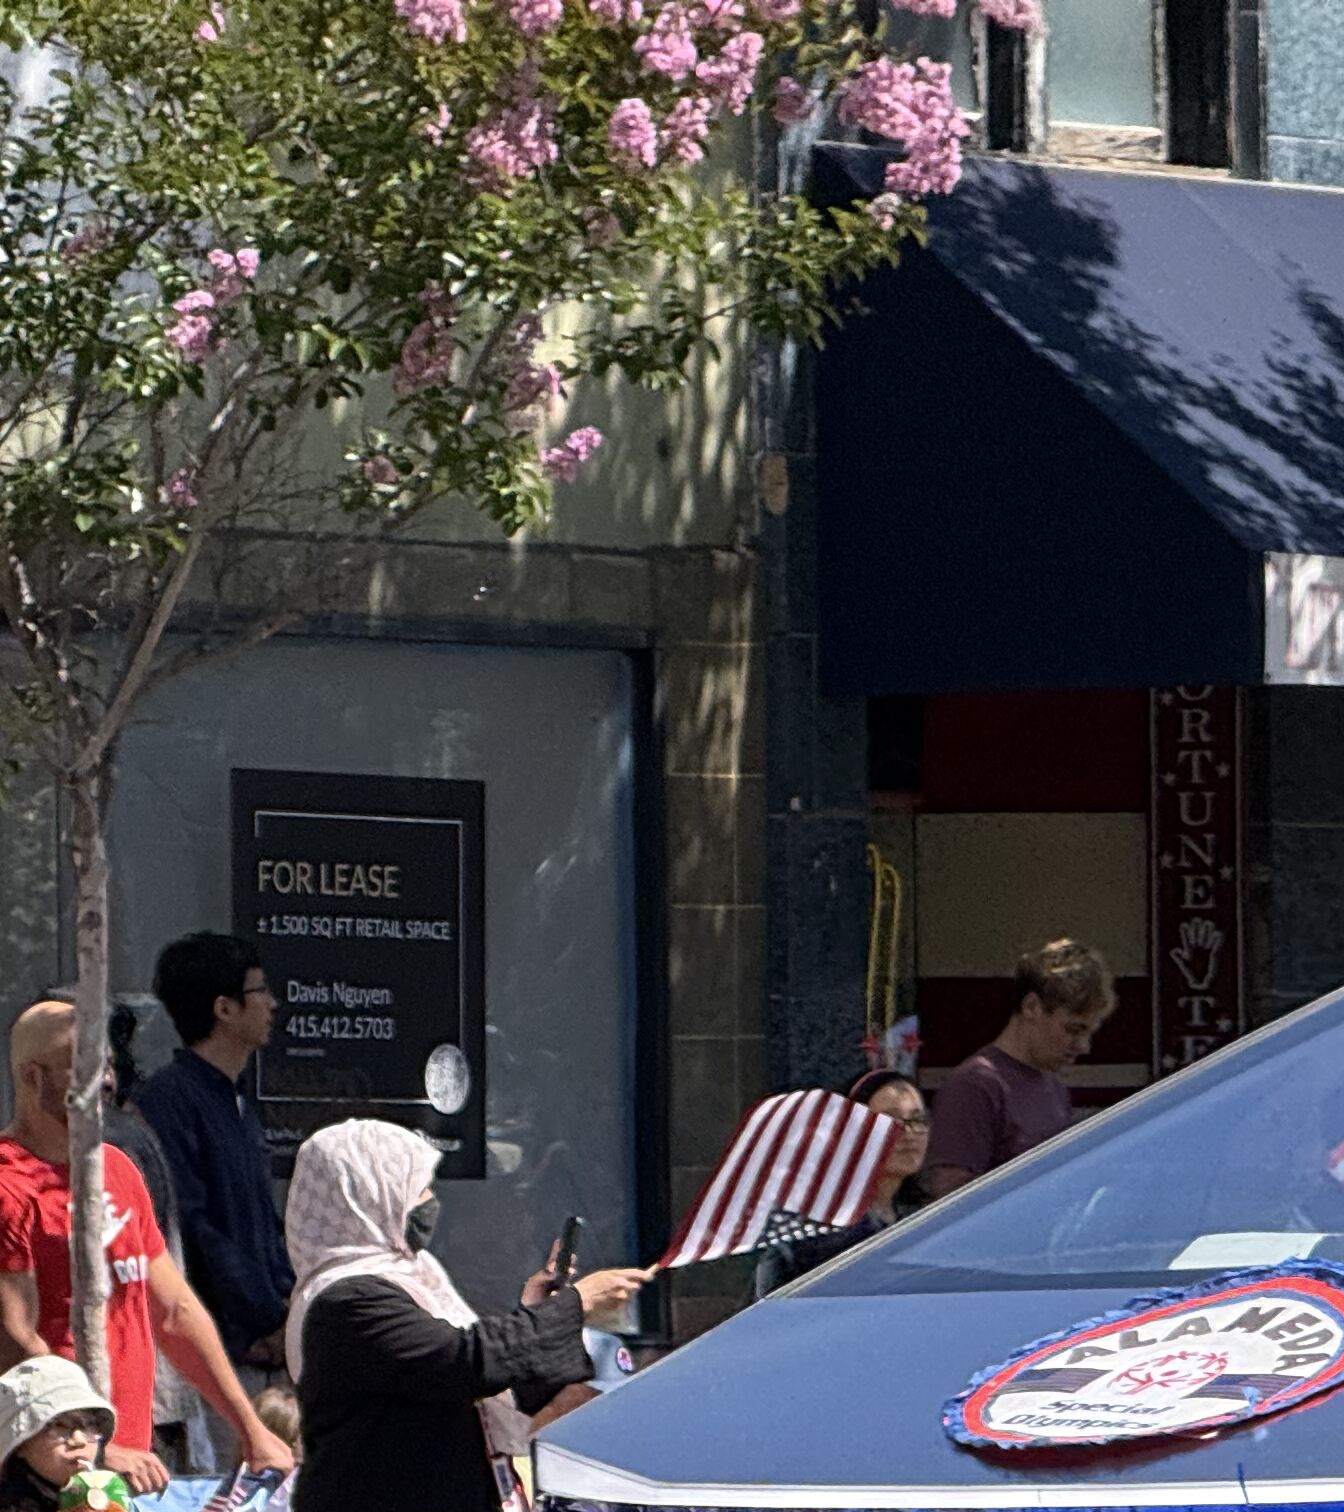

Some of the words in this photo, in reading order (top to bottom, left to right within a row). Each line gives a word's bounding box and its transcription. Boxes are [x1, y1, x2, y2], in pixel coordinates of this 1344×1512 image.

[257, 859, 313, 895] FOR
[319, 863, 401, 898] LEASE
[311, 916, 333, 938] SQ
[335, 918, 353, 937] FT
[355, 918, 403, 939] RETAIL
[405, 920, 451, 941] SPACE
[287, 980, 329, 1003] Davis
[332, 981, 393, 1009] Nguyen
[286, 1015, 395, 1040] 415.412.5703
[1066, 1305, 1334, 1374] ALAMEDA
[1038, 1399, 1175, 1415] Special
[1001, 1413, 1160, 1430] Olympics
